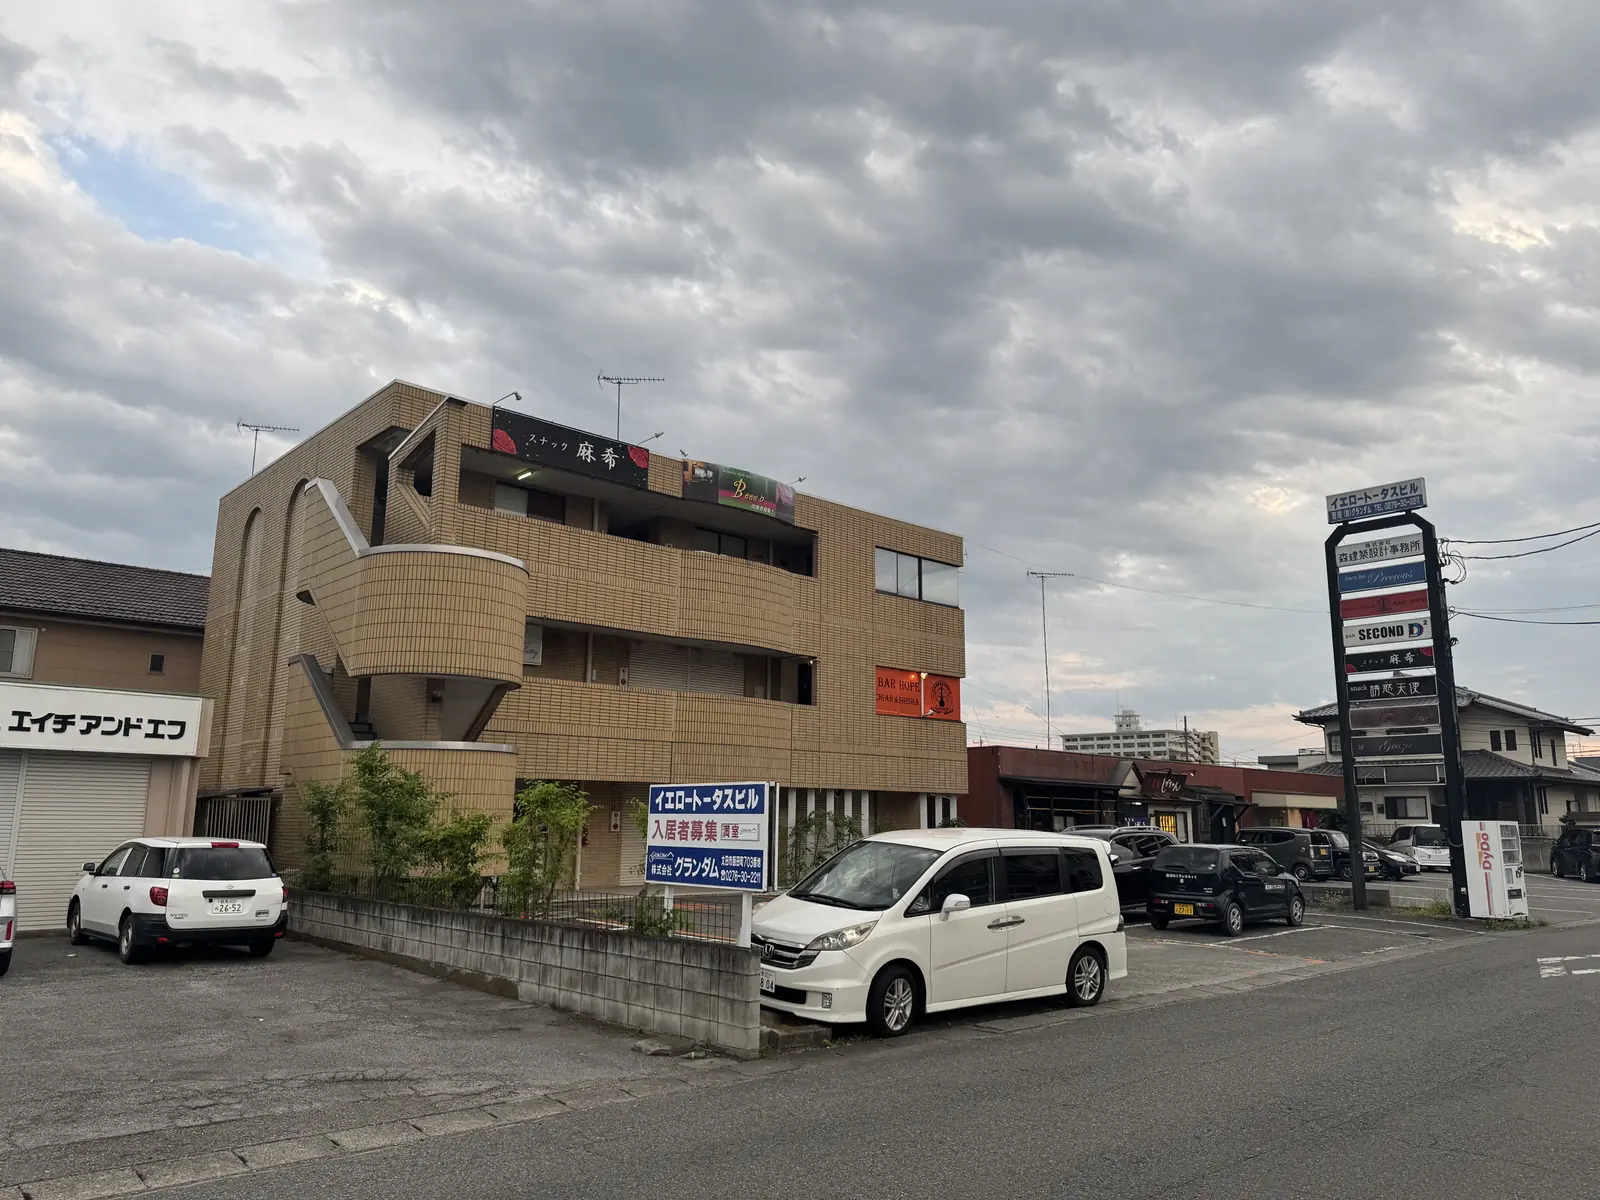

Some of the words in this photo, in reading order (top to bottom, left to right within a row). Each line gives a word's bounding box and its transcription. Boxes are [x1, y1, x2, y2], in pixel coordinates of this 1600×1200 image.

[529, 433, 568, 451] スナック
[1330, 482, 1419, 510] イエロートータスビル
[1358, 625, 1404, 641] SECOND
[878, 677, 896, 689] BAR
[899, 680, 921, 692] HOPE
[1350, 684, 1368, 692] snack
[8, 710, 187, 740] エイチアンドエフ
[655, 788, 759, 812] イエロートータスビル
[652, 819, 718, 842] 入居者募集
[722, 823, 740, 838] 満室
[1479, 832, 1495, 871] DyDo
[651, 864, 672, 876] 株式会社
[674, 856, 719, 879] グランダム
